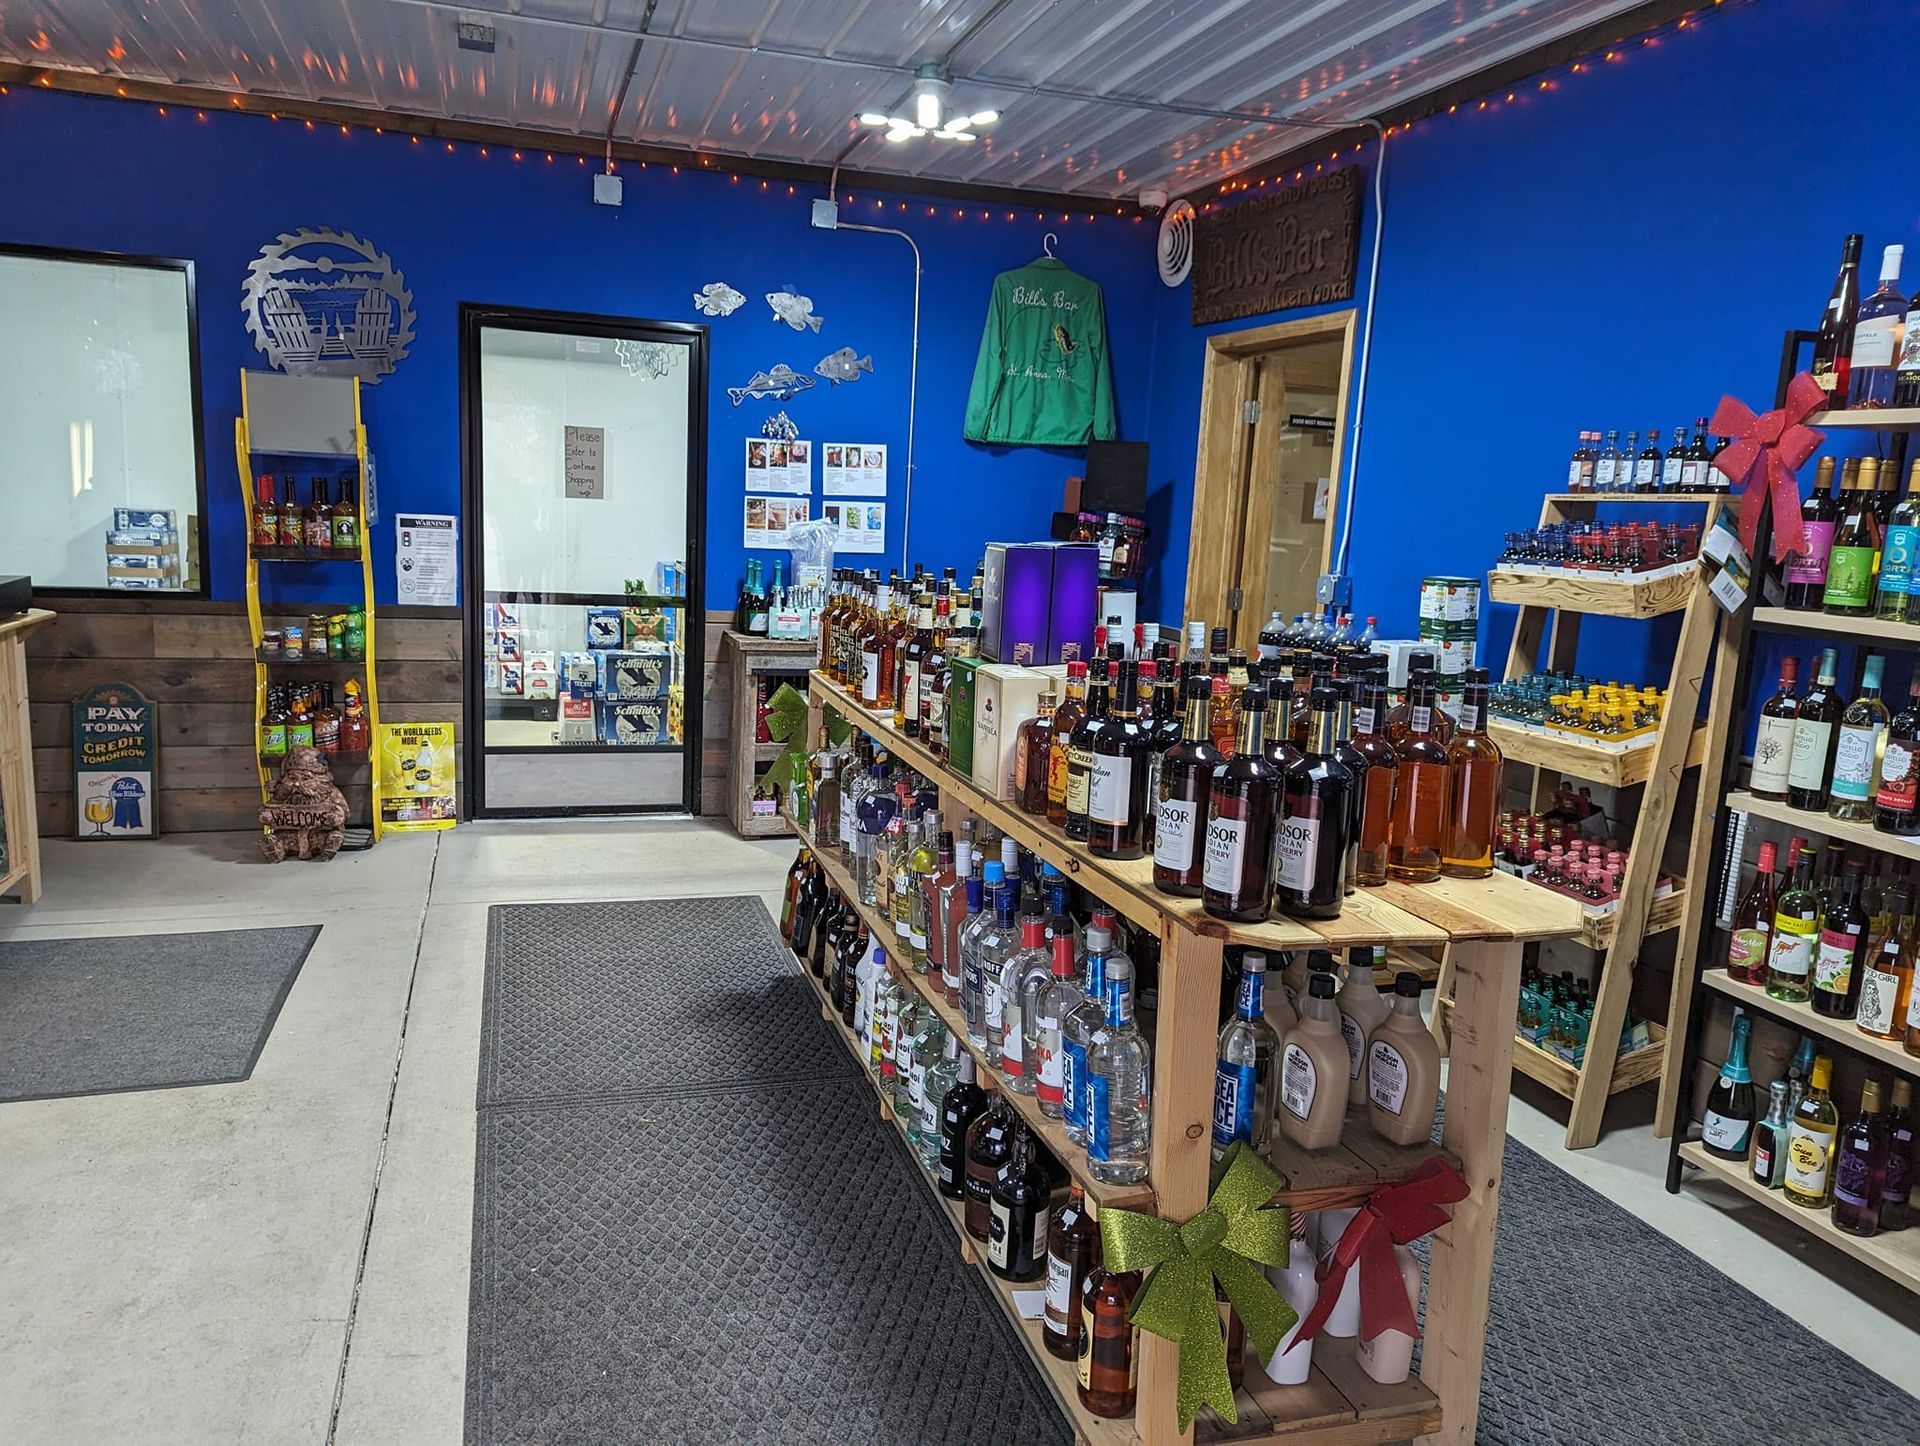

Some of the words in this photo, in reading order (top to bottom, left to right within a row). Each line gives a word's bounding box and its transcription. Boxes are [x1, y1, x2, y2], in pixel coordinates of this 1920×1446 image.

[1274, 215, 1333, 284] Bar
[1012, 287, 1048, 306] Bill's
[1053, 290, 1079, 310] Bar
[566, 428, 600, 442] Please
[566, 445, 584, 456] Enter
[590, 448, 596, 456] to
[565, 458, 596, 470] Continue
[566, 472, 594, 489] Shopping
[614, 658, 663, 669] Schmidt's
[88, 707, 144, 720] PAY
[614, 704, 662, 715] Schmidt's
[82, 723, 144, 732] TODAY
[392, 728, 402, 736] THE
[403, 728, 422, 736] WORLD
[423, 728, 442, 736] NEEDS
[84, 736, 145, 754] CREDIT
[402, 737, 418, 746] MORE
[81, 750, 146, 764] TOMORROW
[116, 781, 138, 790] Pabst
[273, 811, 327, 828] WELCOME
[1158, 804, 1190, 824] DSOR
[1208, 824, 1238, 844] DSOR
[1281, 822, 1312, 842] DSOR
[1878, 974, 1897, 984] GIRL
[1289, 1052, 1308, 1068] JACKSON
[1376, 1048, 1398, 1063] JACKSON
[1376, 1054, 1398, 1068] MORGAN
[1288, 1056, 1306, 1072] MORGAN
[1215, 1075, 1234, 1102] SEA
[1793, 1143, 1813, 1157] Sun
[1800, 1154, 1818, 1168] Bee
[966, 1178, 990, 1196] KRAKEN
